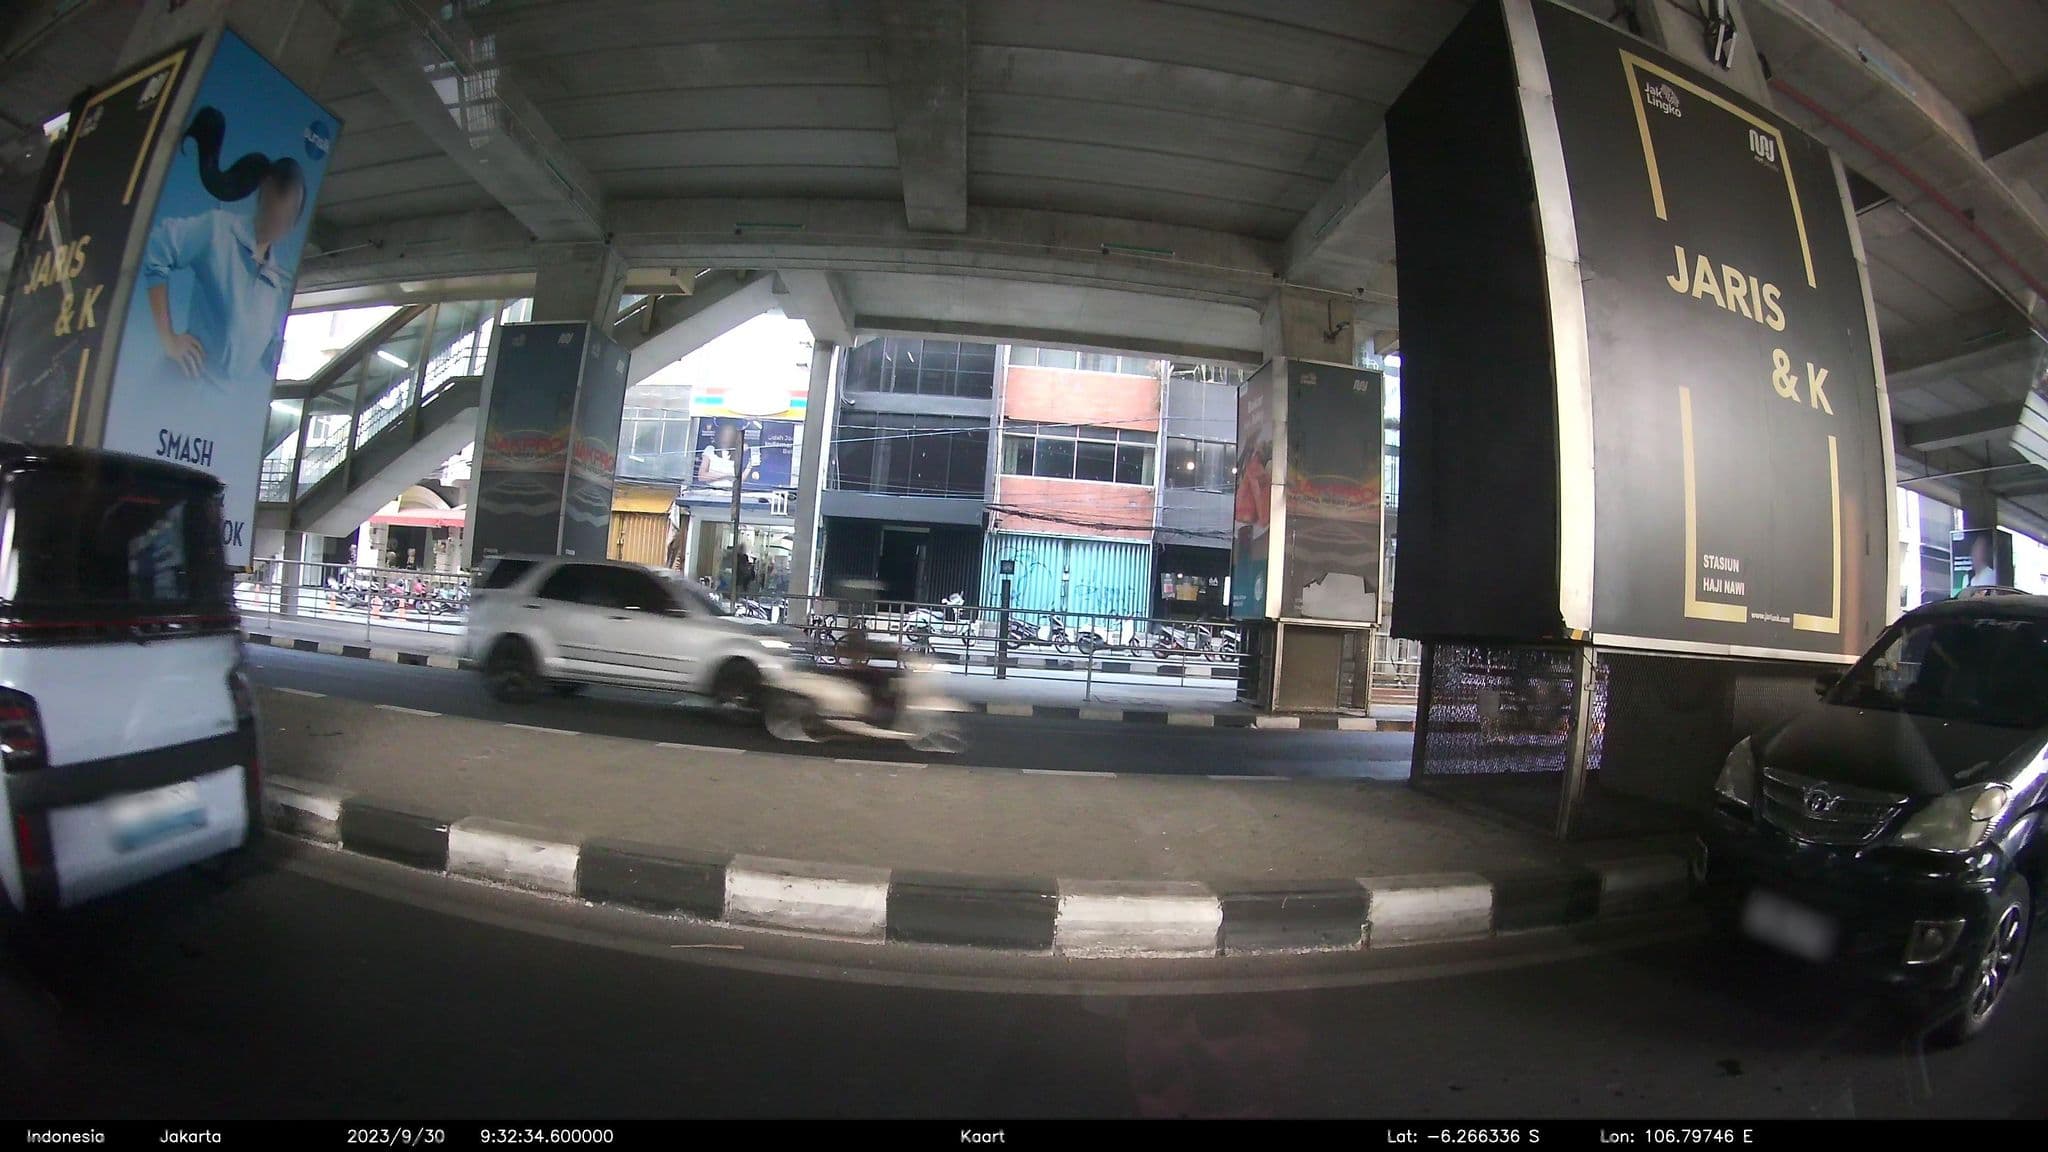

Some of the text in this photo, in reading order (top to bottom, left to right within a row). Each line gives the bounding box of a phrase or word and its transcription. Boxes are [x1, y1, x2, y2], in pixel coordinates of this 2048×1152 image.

[1644, 81, 1663, 100] Jak
[1646, 92, 1682, 118] Lingko
[1666, 244, 1787, 332] JARIS
[77, 284, 105, 331] K
[1772, 347, 1835, 416] & K
[156, 428, 214, 467] SMASH
[1703, 554, 1740, 573] STASIUN
[1702, 577, 1745, 596] HAJI NAWI
